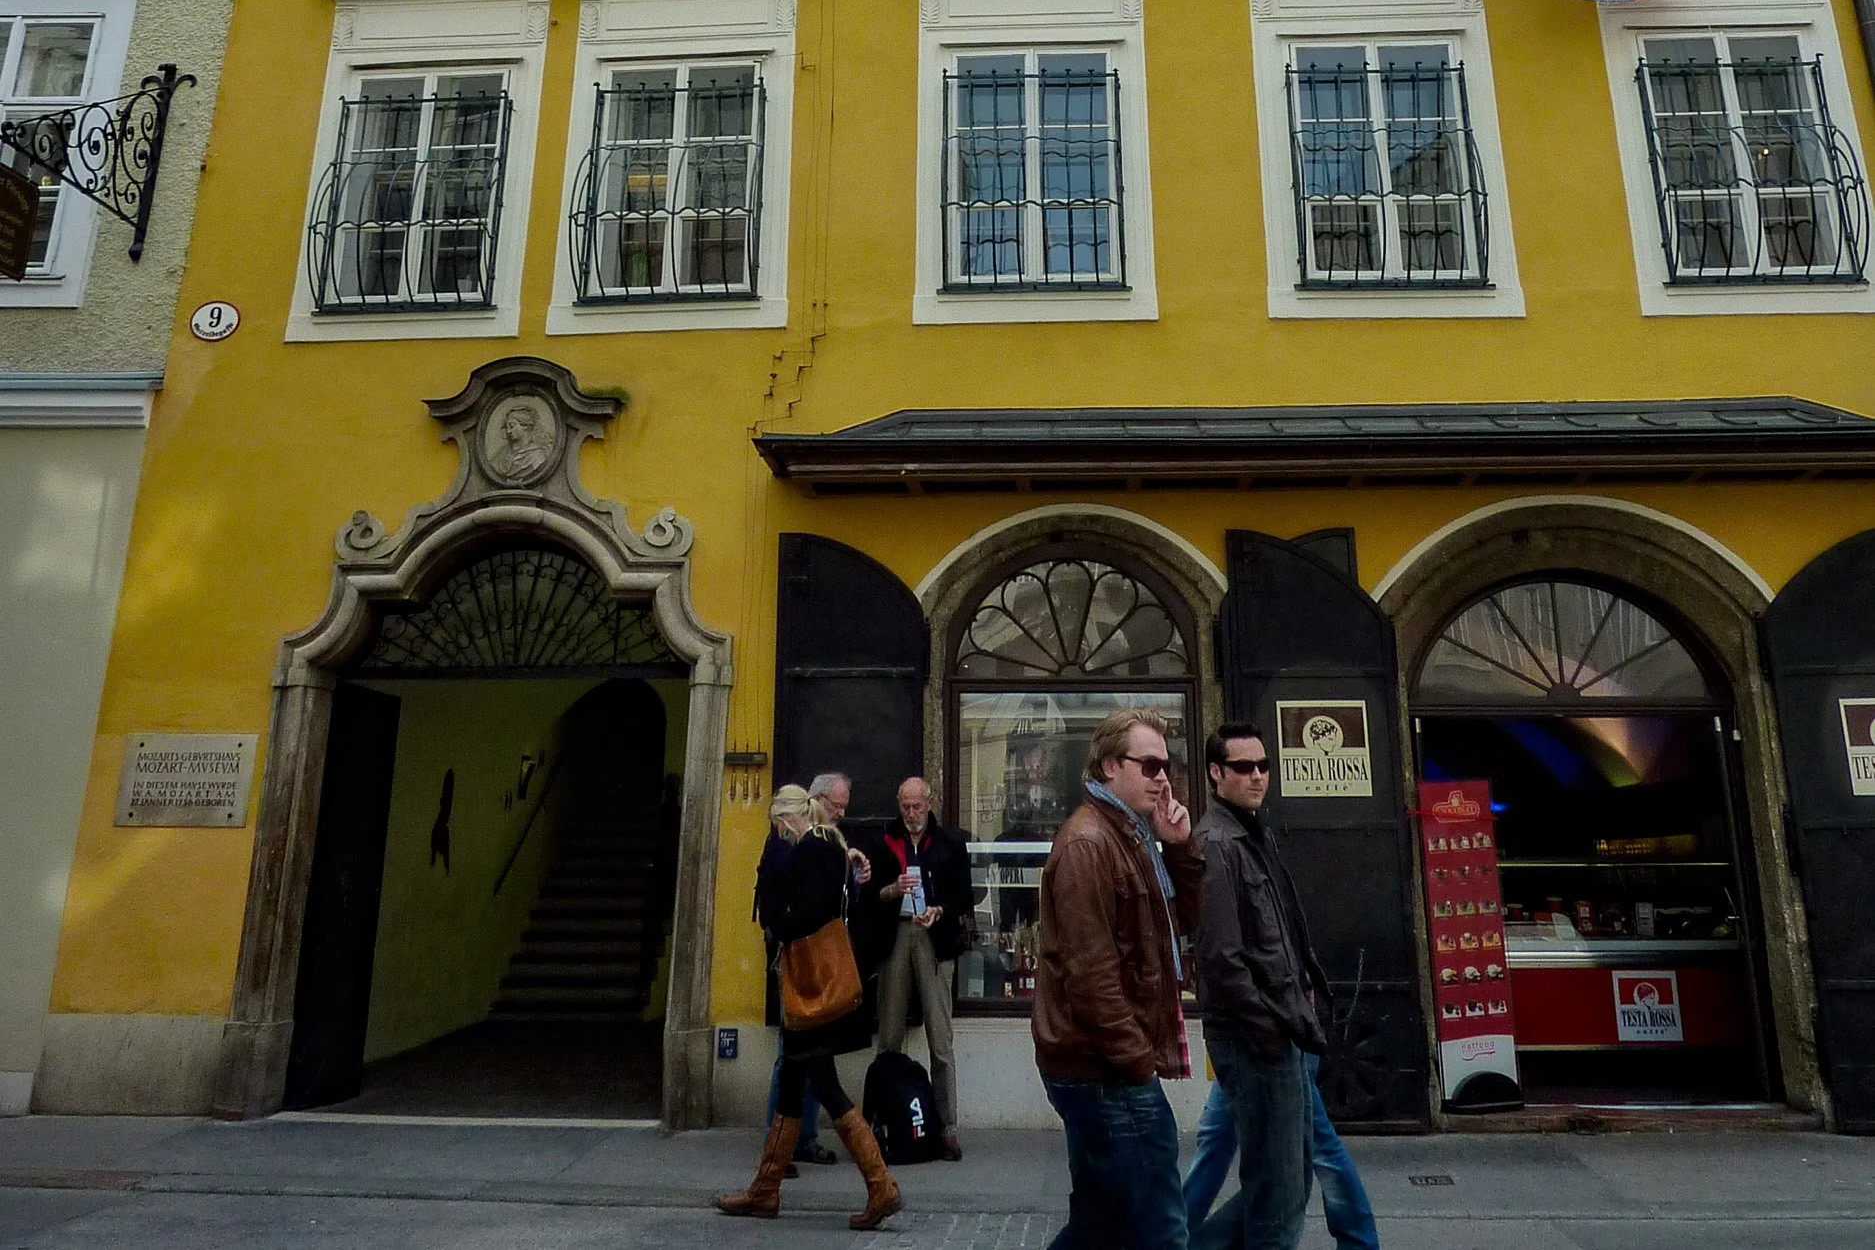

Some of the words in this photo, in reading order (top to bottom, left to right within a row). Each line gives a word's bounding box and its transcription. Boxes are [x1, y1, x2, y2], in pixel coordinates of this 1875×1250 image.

[209, 306, 222, 328] 9
[137, 752, 179, 762] MOZARTS
[1283, 757, 1324, 781] TESTA
[1327, 757, 1369, 781] ROSSA
[133, 781, 144, 789] IN
[146, 781, 178, 789] DIESEM
[157, 790, 210, 798] MOZART
[215, 790, 236, 798] AM
[1621, 1011, 1648, 1027] TESTA
[1649, 1011, 1677, 1027] ROSSA
[910, 1097, 925, 1140] FILA
